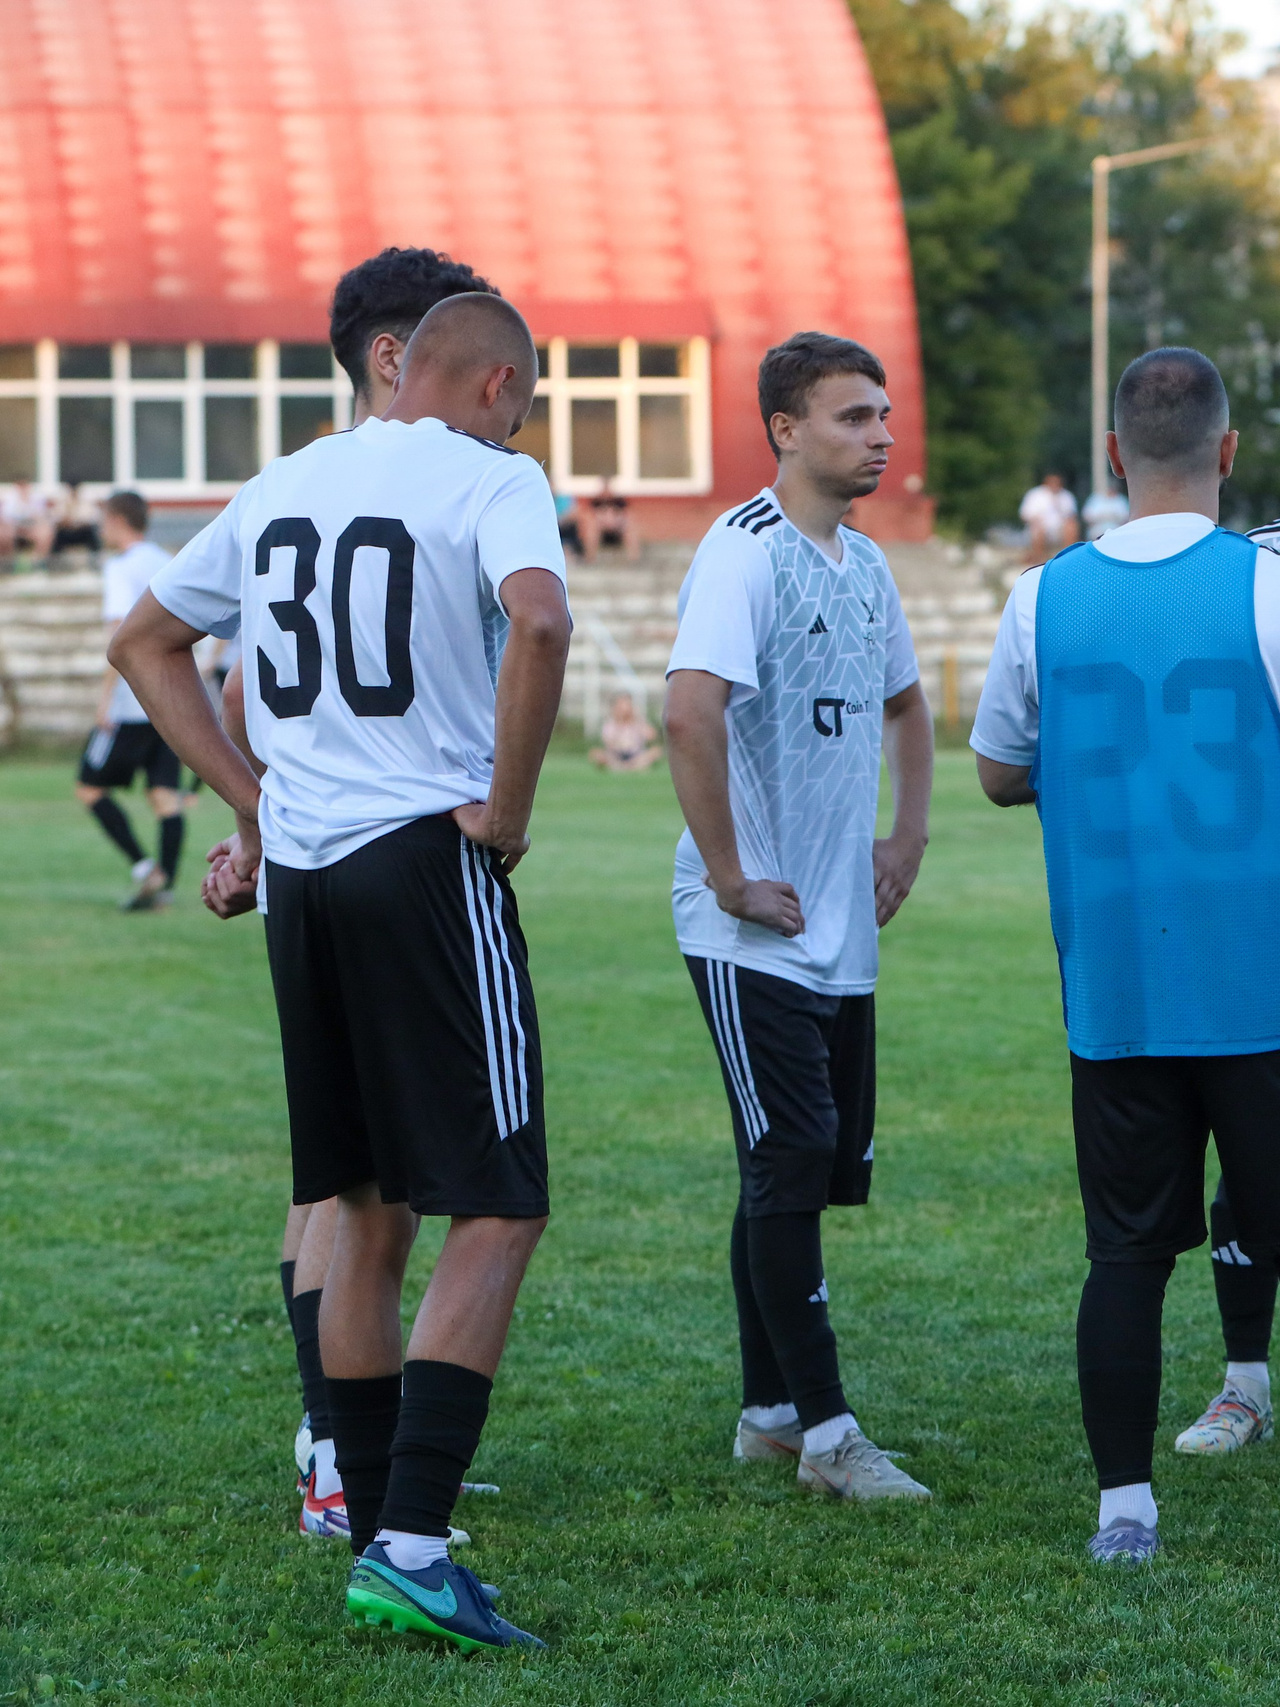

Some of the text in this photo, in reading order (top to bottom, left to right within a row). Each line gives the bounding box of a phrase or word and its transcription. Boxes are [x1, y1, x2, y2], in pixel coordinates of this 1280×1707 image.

[255, 516, 416, 719] 30
[846, 701, 863, 715] Coin
[1051, 658, 1265, 861] 23
